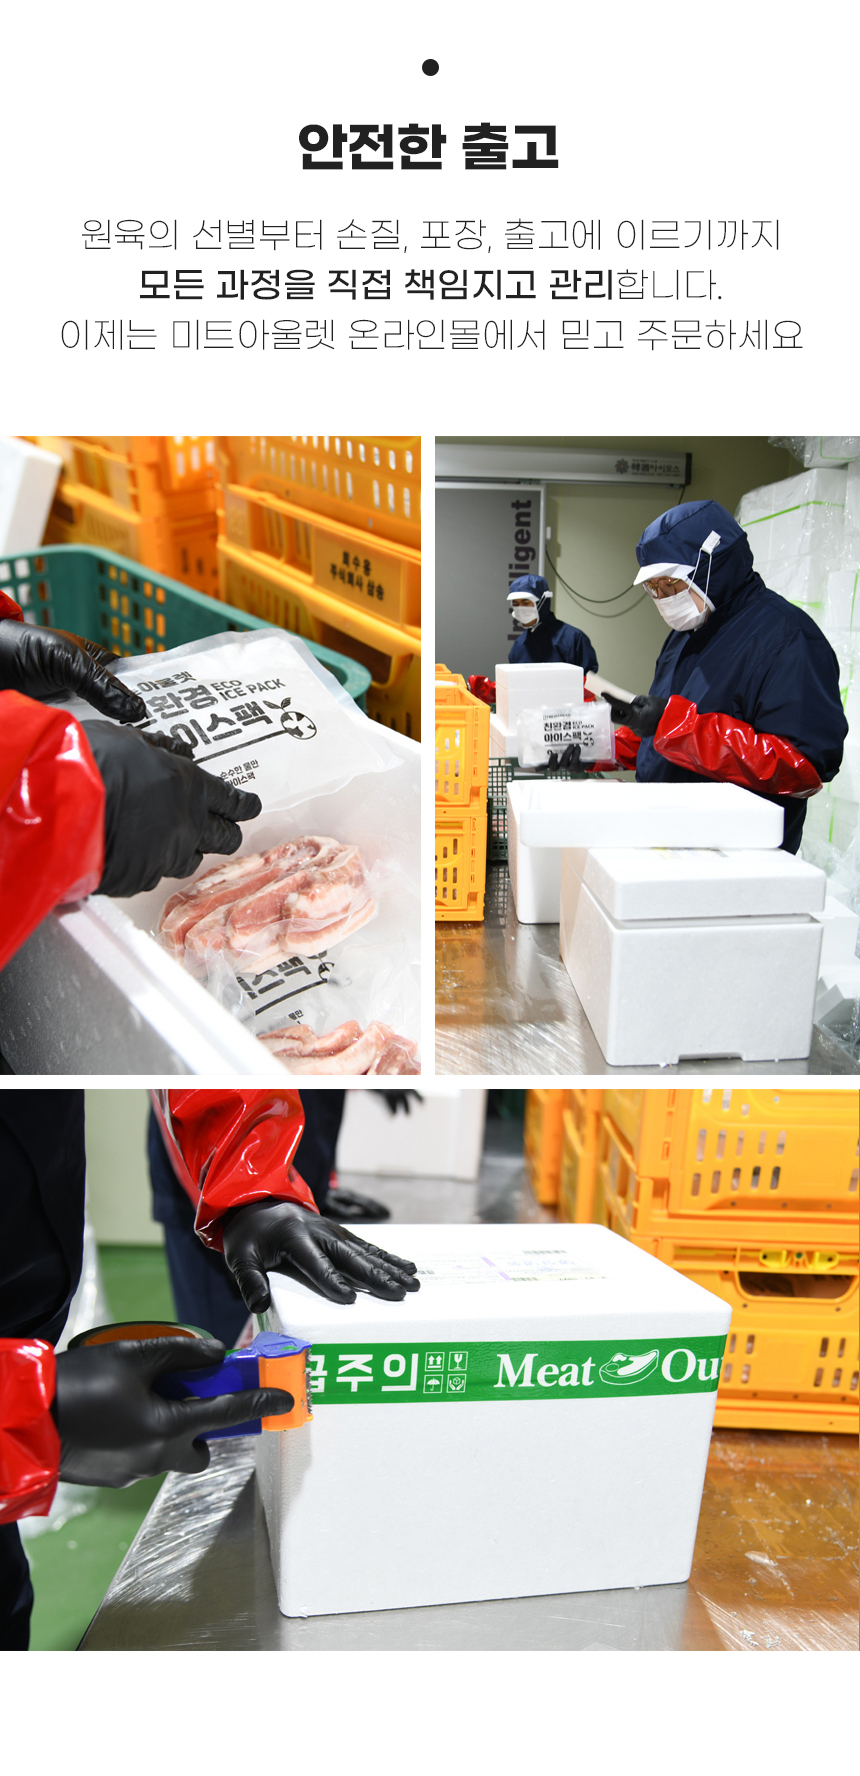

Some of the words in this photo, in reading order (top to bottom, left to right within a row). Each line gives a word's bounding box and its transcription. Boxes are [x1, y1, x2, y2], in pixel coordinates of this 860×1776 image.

[330, 563, 363, 592] 주식회사
[343, 550, 371, 577] 회수용
[210, 679, 243, 691] ECO
[219, 687, 247, 702] ICE
[245, 678, 287, 695] PACK
[133, 684, 219, 729] 환경
[155, 700, 273, 749] 이스팩
[544, 731, 582, 742] 아이스팩
[494, 1353, 596, 1388] Meat
[661, 1348, 723, 1383] Ou
